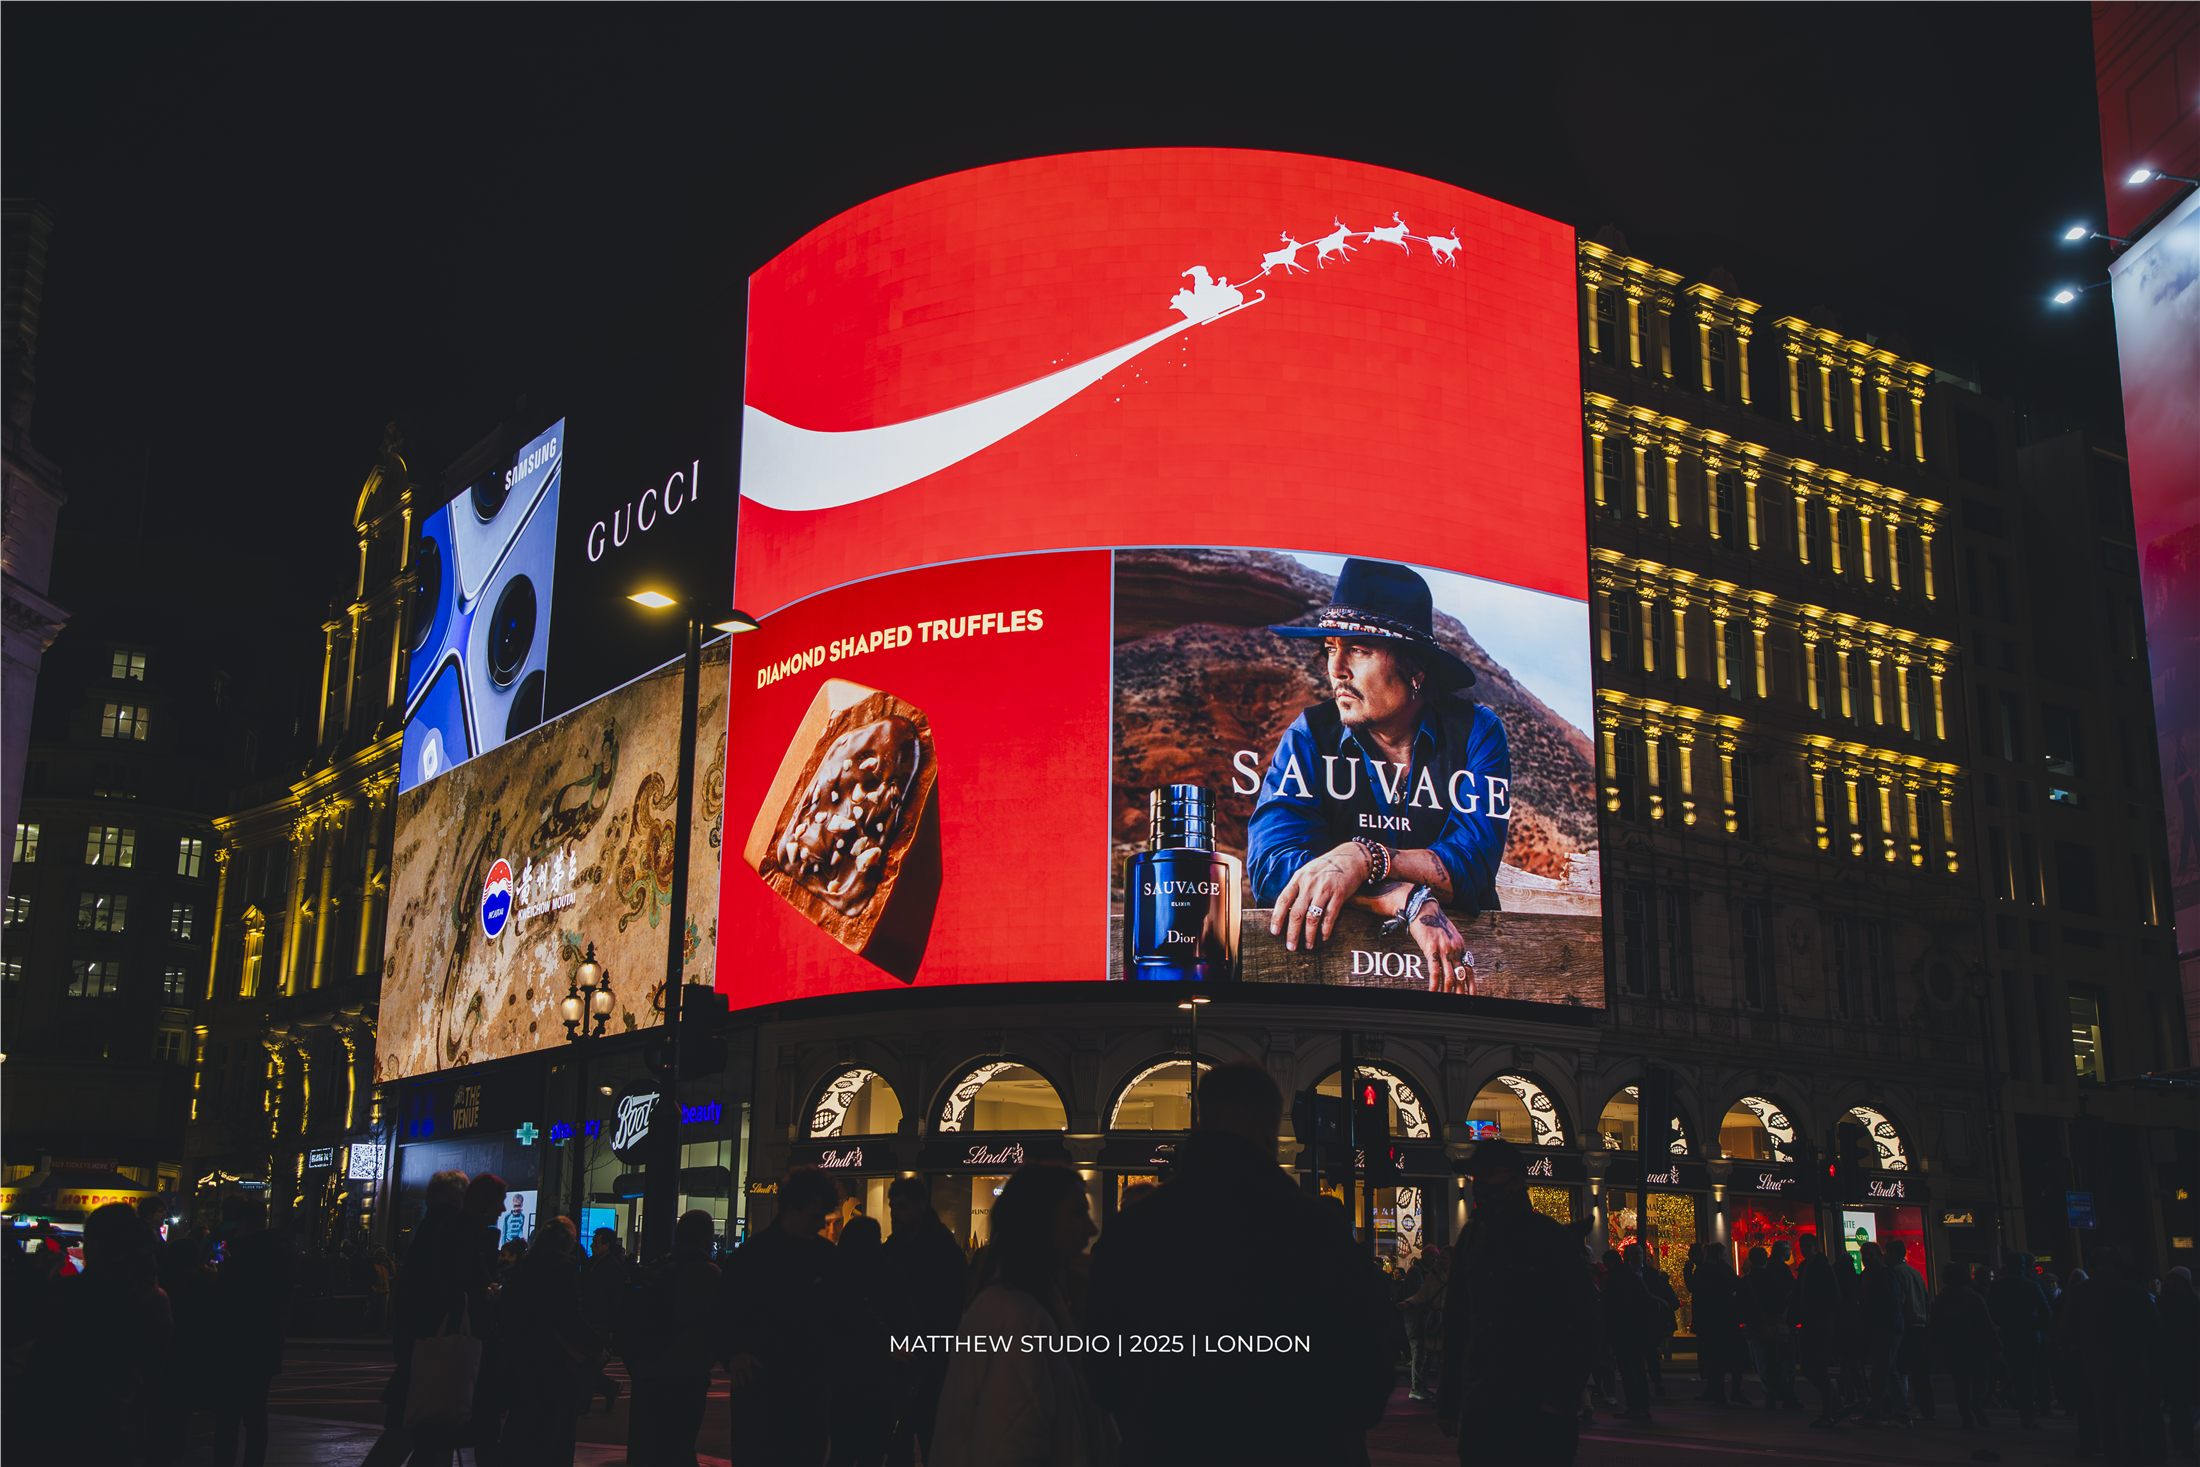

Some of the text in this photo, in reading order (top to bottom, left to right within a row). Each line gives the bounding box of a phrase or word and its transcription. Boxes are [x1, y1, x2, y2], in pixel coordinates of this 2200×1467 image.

[505, 437, 557, 491] SAMSUNG
[587, 460, 700, 562] GUCCI
[757, 609, 1044, 689] DIAMOND SHAPED TRUFFLES
[1232, 750, 1513, 820] SAUVAGE
[1359, 813, 1411, 832] ELIXIR
[1143, 881, 1221, 896] SAUVAGE
[1167, 930, 1195, 944] Dior
[1350, 950, 1425, 980] DIOR
[466, 1084, 481, 1107] THE
[453, 1106, 480, 1131] VENUE
[681, 1098, 723, 1126] beauty
[818, 1150, 856, 1168] Lindt
[963, 1145, 1012, 1164] Lindt
[62, 1194, 88, 1205] HOT
[1868, 1180, 1897, 1198] Lindt
